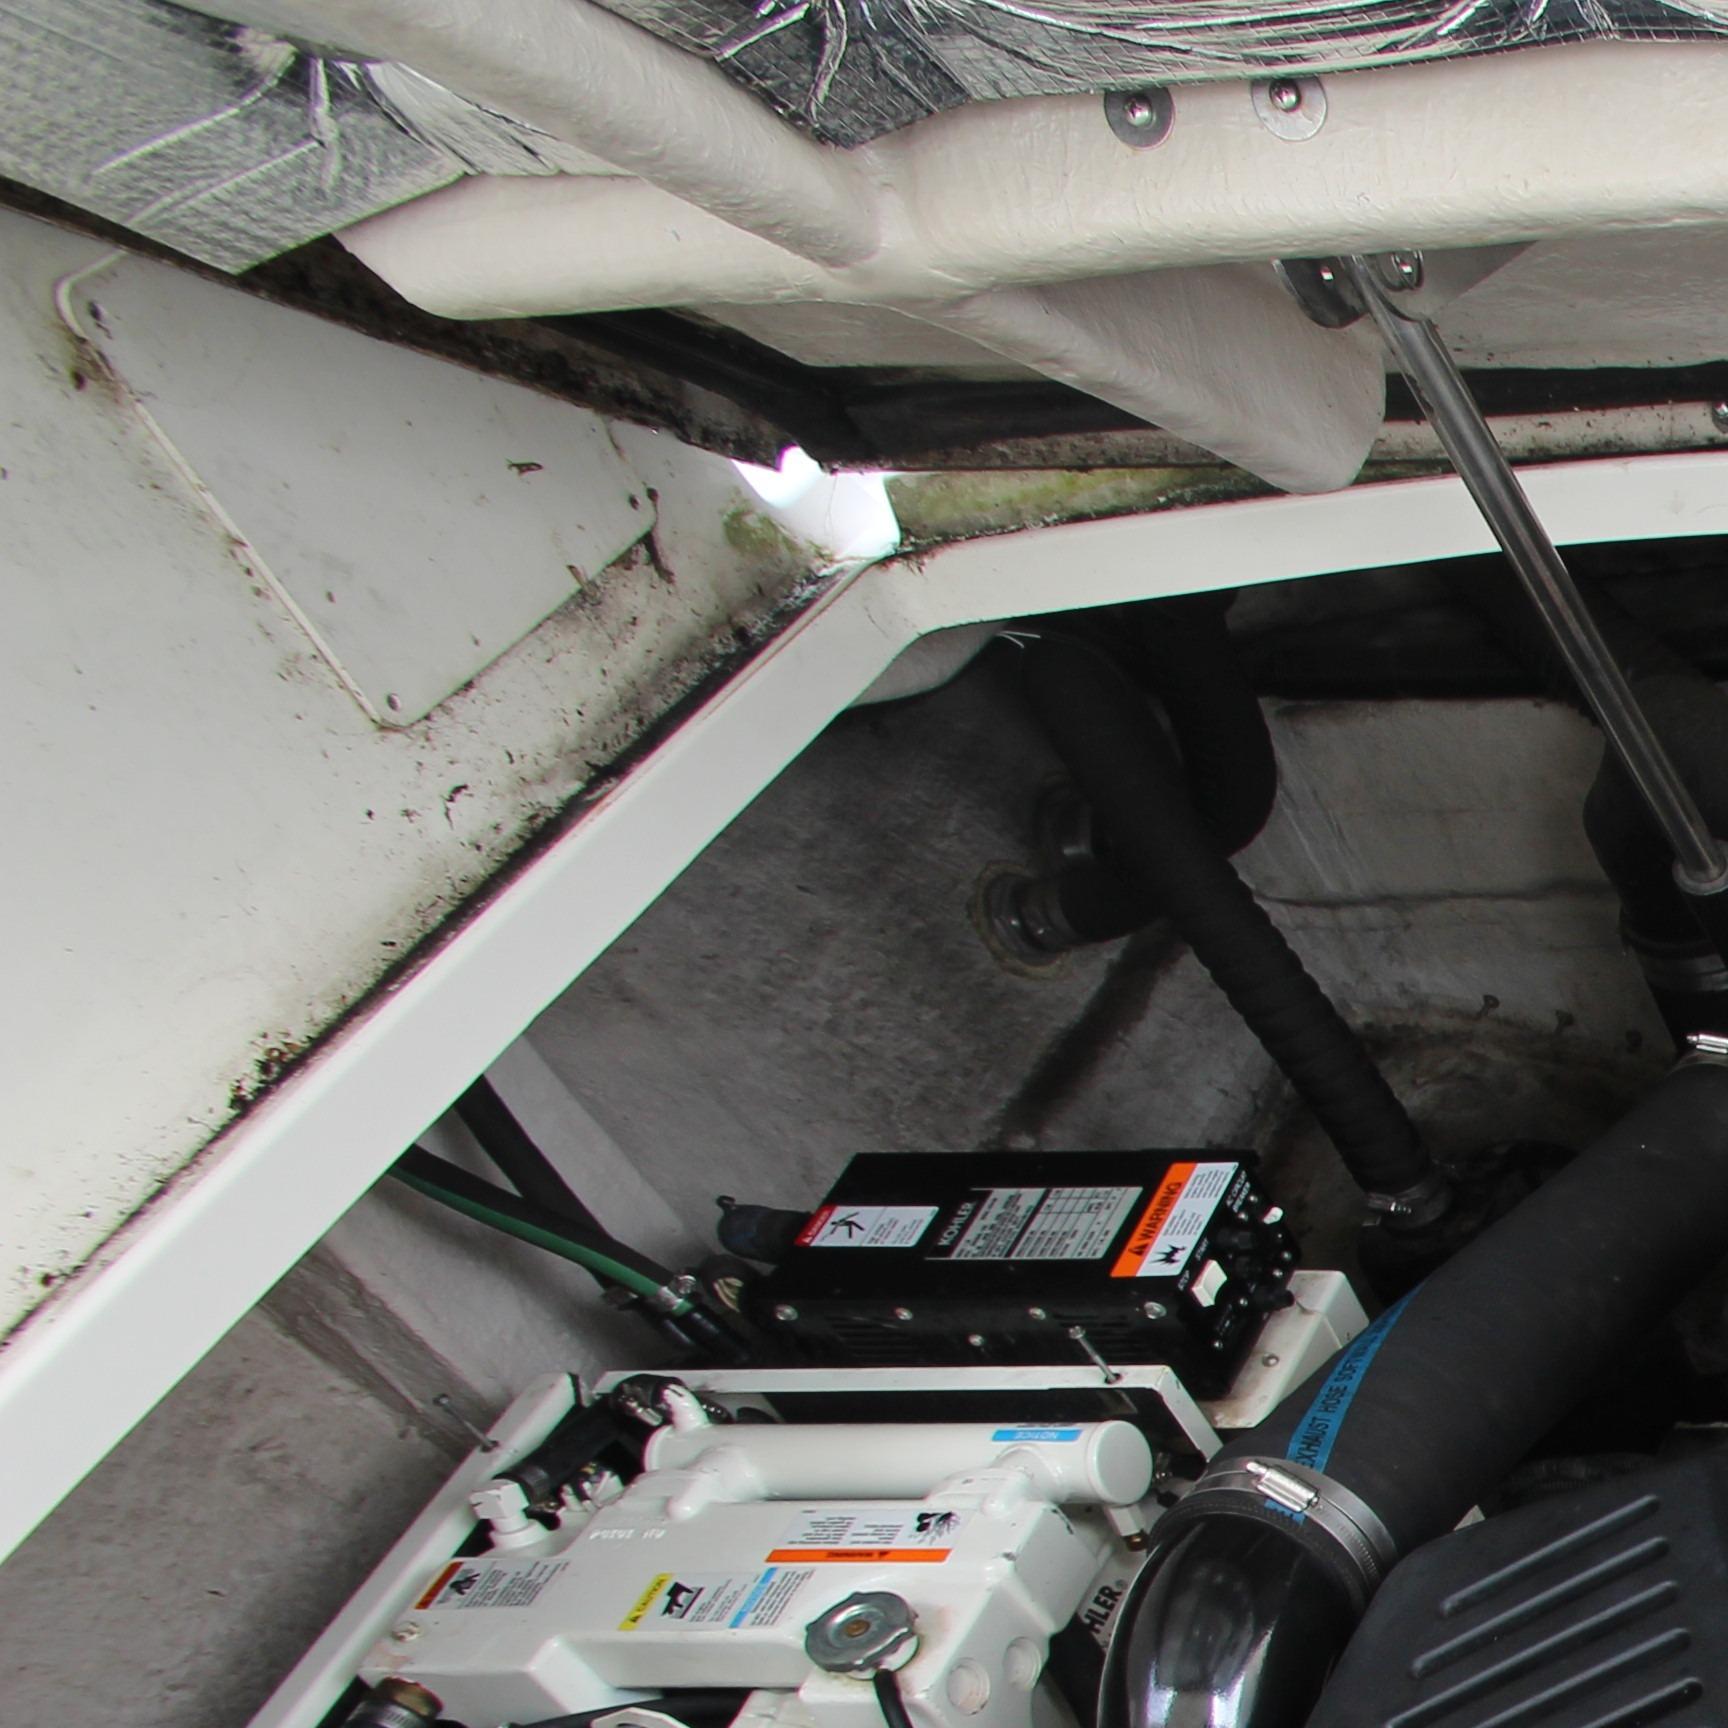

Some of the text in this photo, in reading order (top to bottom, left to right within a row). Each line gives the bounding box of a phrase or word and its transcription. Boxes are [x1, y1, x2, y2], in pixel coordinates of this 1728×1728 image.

[938, 1202, 975, 1246] KOHLER
[1140, 1181, 1182, 1242] WARNING
[1318, 1385, 1348, 1413] HOSE
